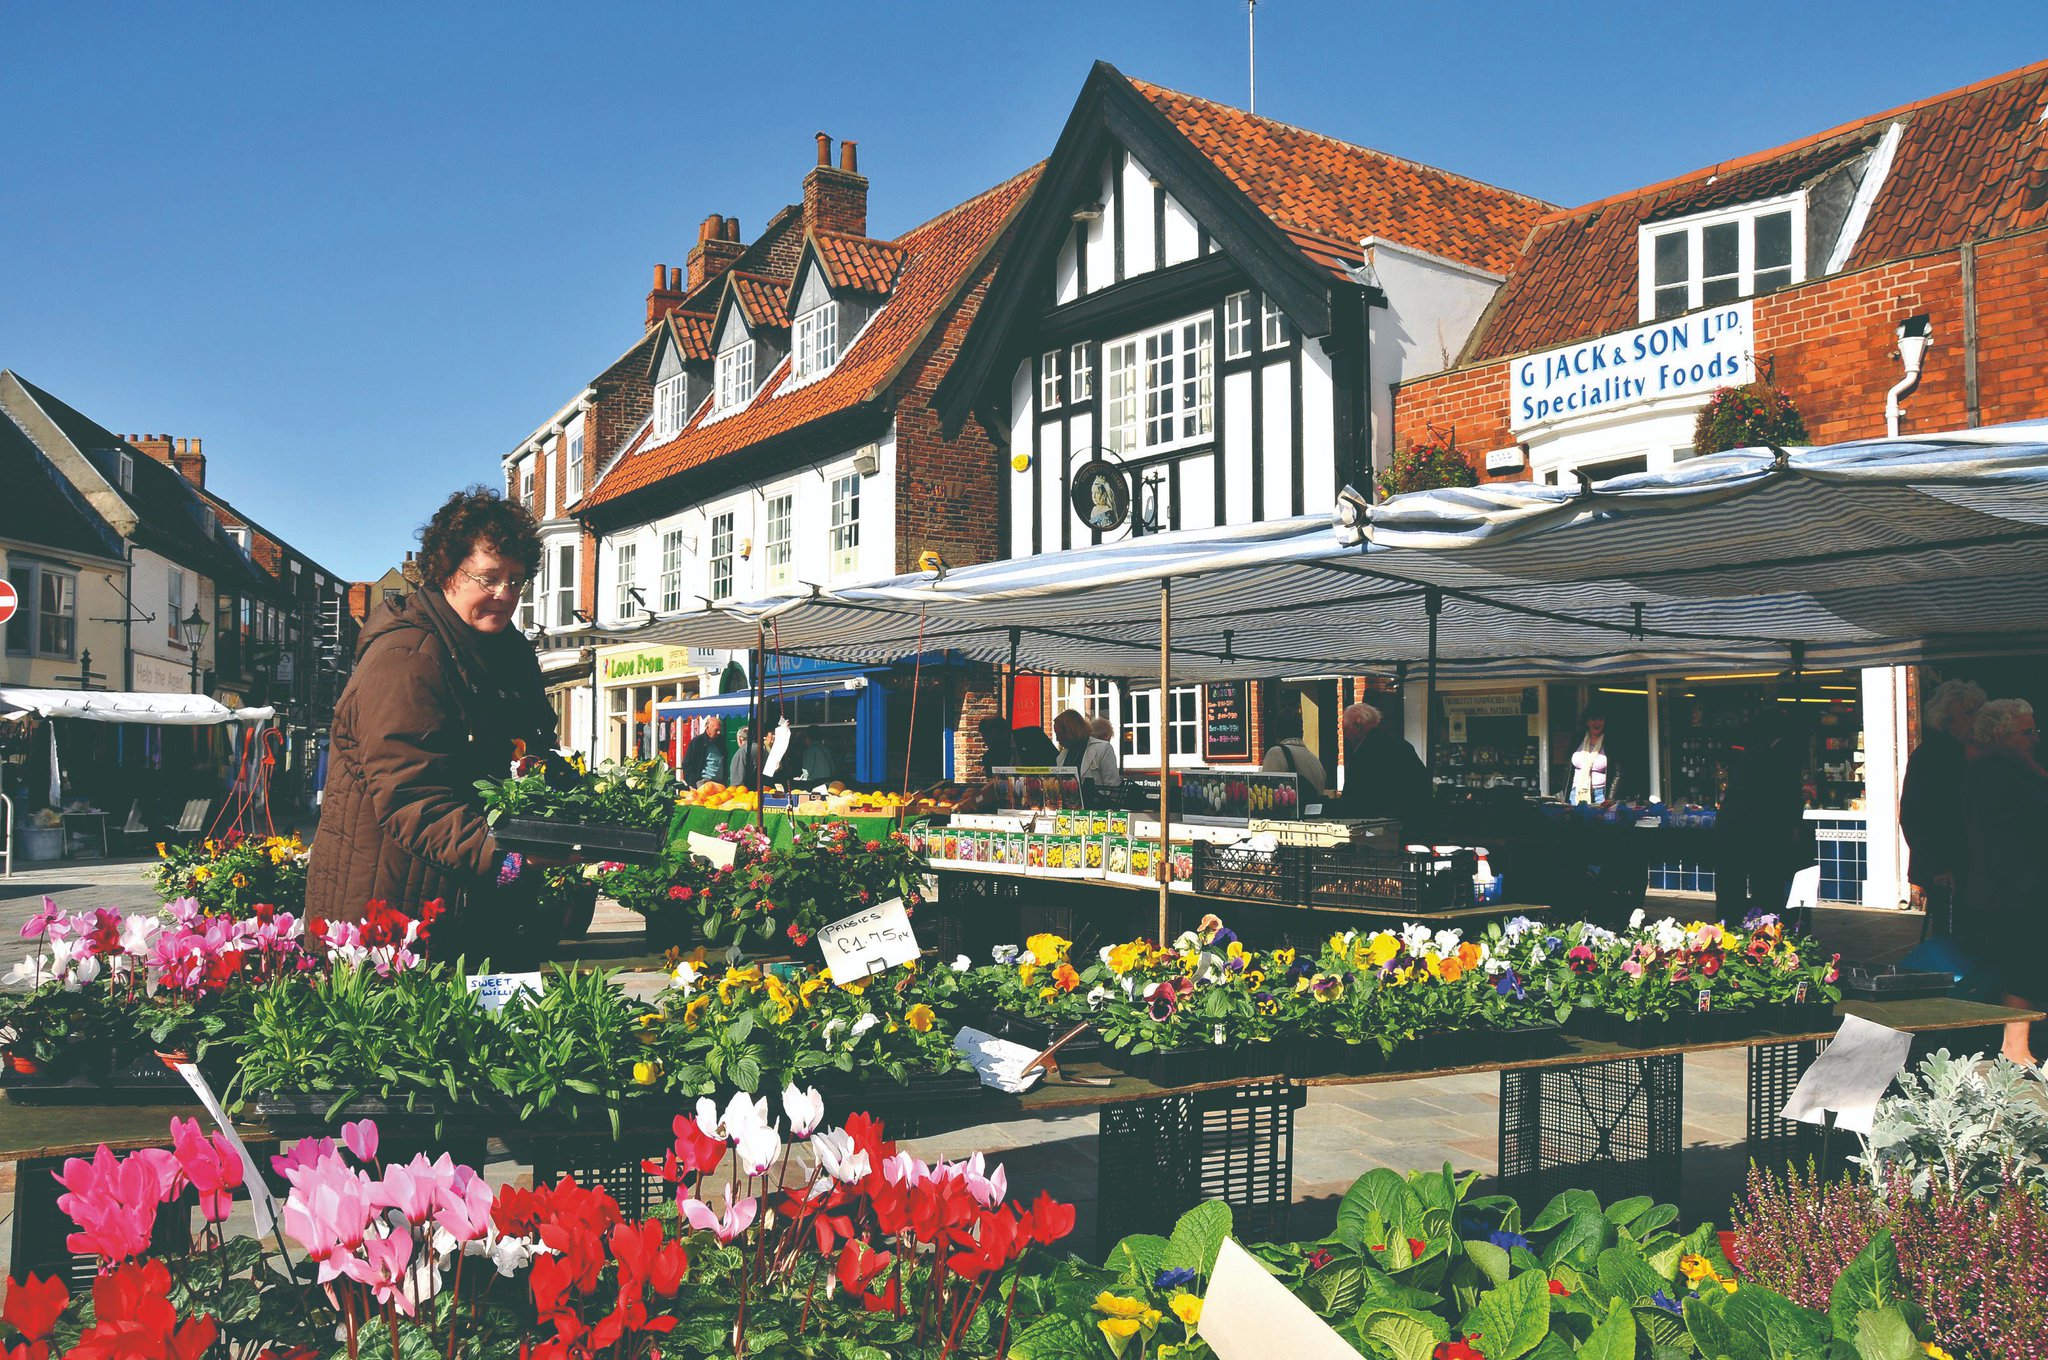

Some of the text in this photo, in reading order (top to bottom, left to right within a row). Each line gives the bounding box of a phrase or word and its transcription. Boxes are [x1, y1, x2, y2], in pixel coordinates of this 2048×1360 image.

[1521, 362, 1535, 387] G
[1545, 344, 1607, 390] JACK
[1633, 323, 1689, 361] SON
[1660, 352, 1740, 390] Foods
[136, 663, 184, 691] Help the Aged
[611, 658, 635, 679] Love
[637, 653, 664, 675] From
[824, 912, 882, 936] PANSIES
[471, 978, 512, 988] SWEET
